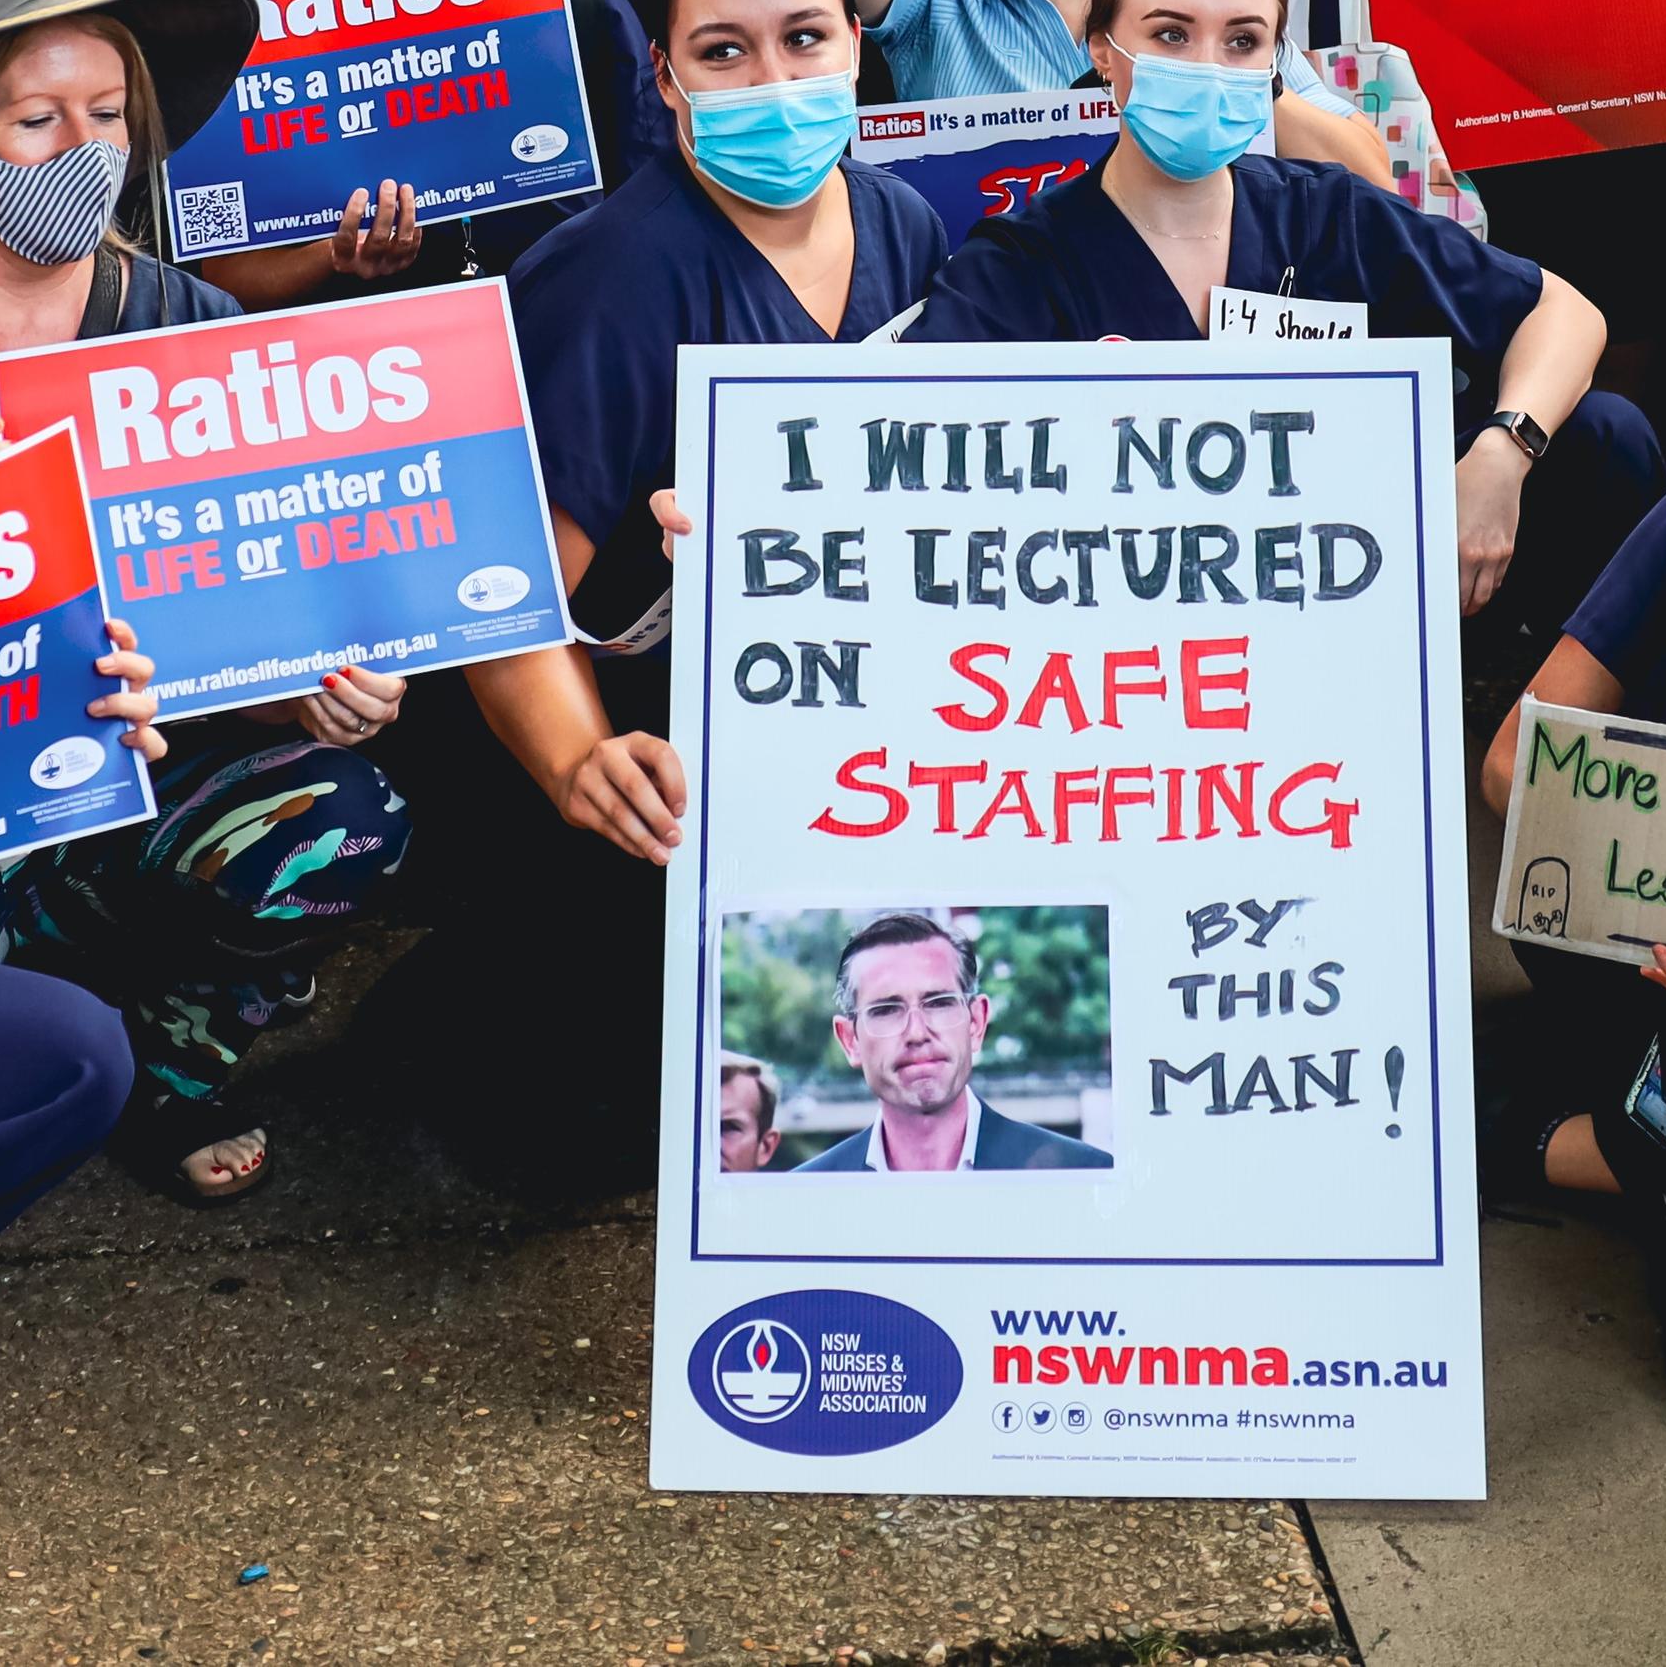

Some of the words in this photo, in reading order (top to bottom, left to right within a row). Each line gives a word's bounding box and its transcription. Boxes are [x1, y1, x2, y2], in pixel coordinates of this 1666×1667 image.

[1455, 114, 1500, 128] Authorised
[1501, 113, 1512, 123] by
[1557, 102, 1589, 115] General
[1634, 93, 1654, 104] NSW
[1219, 298, 1256, 333] 1:4
[88, 341, 429, 471] Ratios
[777, 417, 822, 491] I
[863, 417, 1067, 494] WILL
[1112, 409, 1315, 497] NOT
[739, 528, 868, 602] BE
[906, 522, 1383, 609] LECTURED
[734, 640, 870, 709] ON
[934, 636, 1250, 734] SAFE
[1530, 723, 1659, 812] More
[808, 747, 1360, 849] STAFFING
[1531, 884, 1556, 900] RIP
[1186, 898, 1311, 957] BY
[1169, 963, 1345, 1022] THIS
[992, 1308, 1125, 1336] www.
[820, 1334, 861, 1351] NSW
[820, 1355, 886, 1372] NURSES
[891, 1355, 904, 1372] &
[993, 1344, 1448, 1388] nswnma.asn.au
[820, 1376, 907, 1392] MIDWIVES'
[820, 1395, 927, 1413] ASSOCIATION
[1104, 1407, 1228, 1430] @nswnma
[1236, 1408, 1355, 1429] #nswnma
